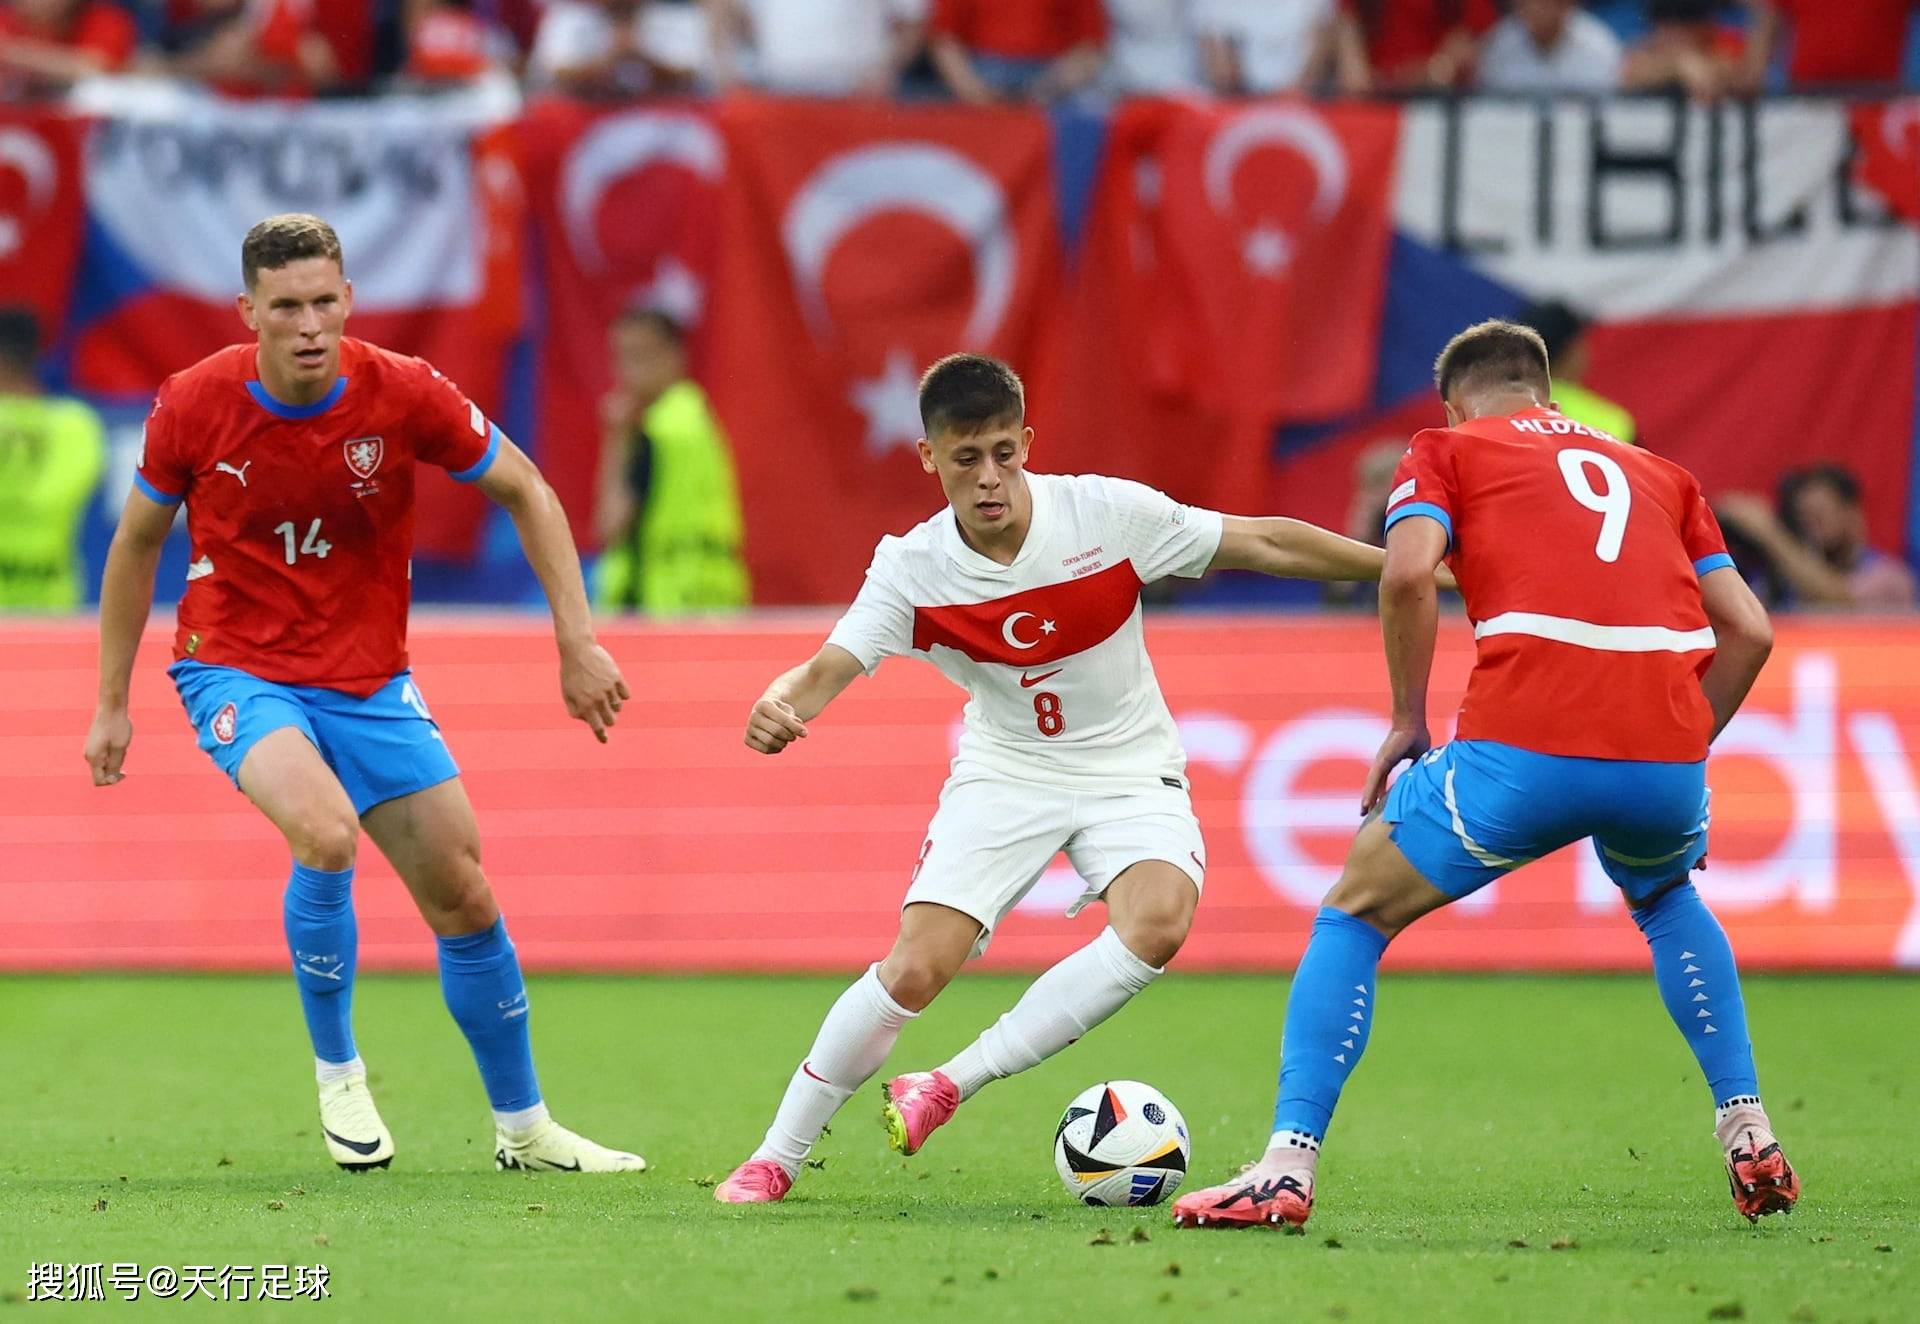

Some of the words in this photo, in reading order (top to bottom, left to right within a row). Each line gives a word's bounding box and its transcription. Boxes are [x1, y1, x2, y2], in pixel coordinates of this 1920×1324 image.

[1557, 448, 1632, 563] 9
[274, 518, 333, 565] 14
[1033, 691, 1066, 737] 8
[497, 991, 527, 1009] CZ
